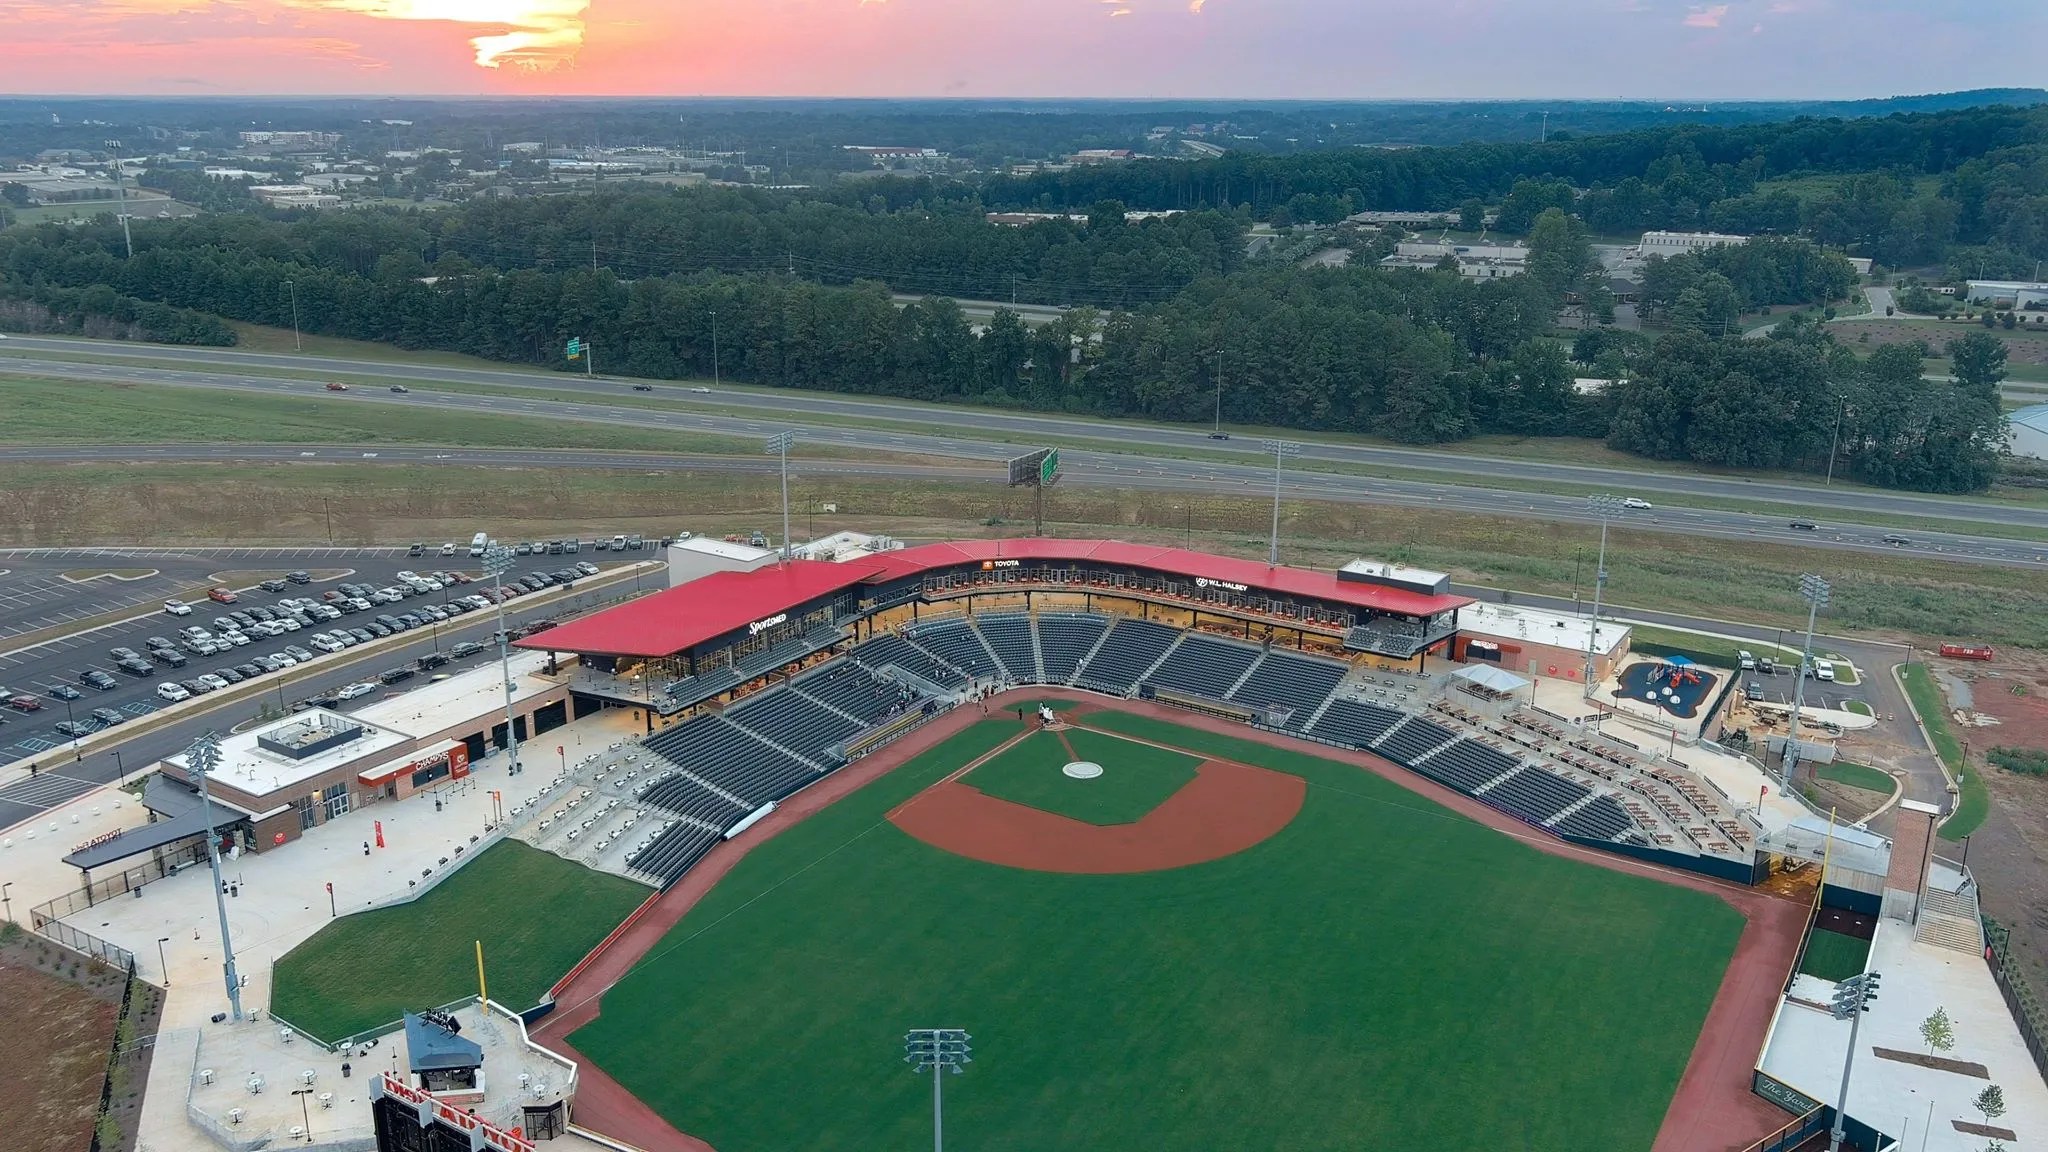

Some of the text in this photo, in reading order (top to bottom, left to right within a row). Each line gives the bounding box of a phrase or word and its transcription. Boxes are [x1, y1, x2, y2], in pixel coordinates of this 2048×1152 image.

[1222, 581, 1248, 591] HALSEY
[1762, 1079, 1782, 1096] The
[1783, 1090, 1814, 1111] Yard
